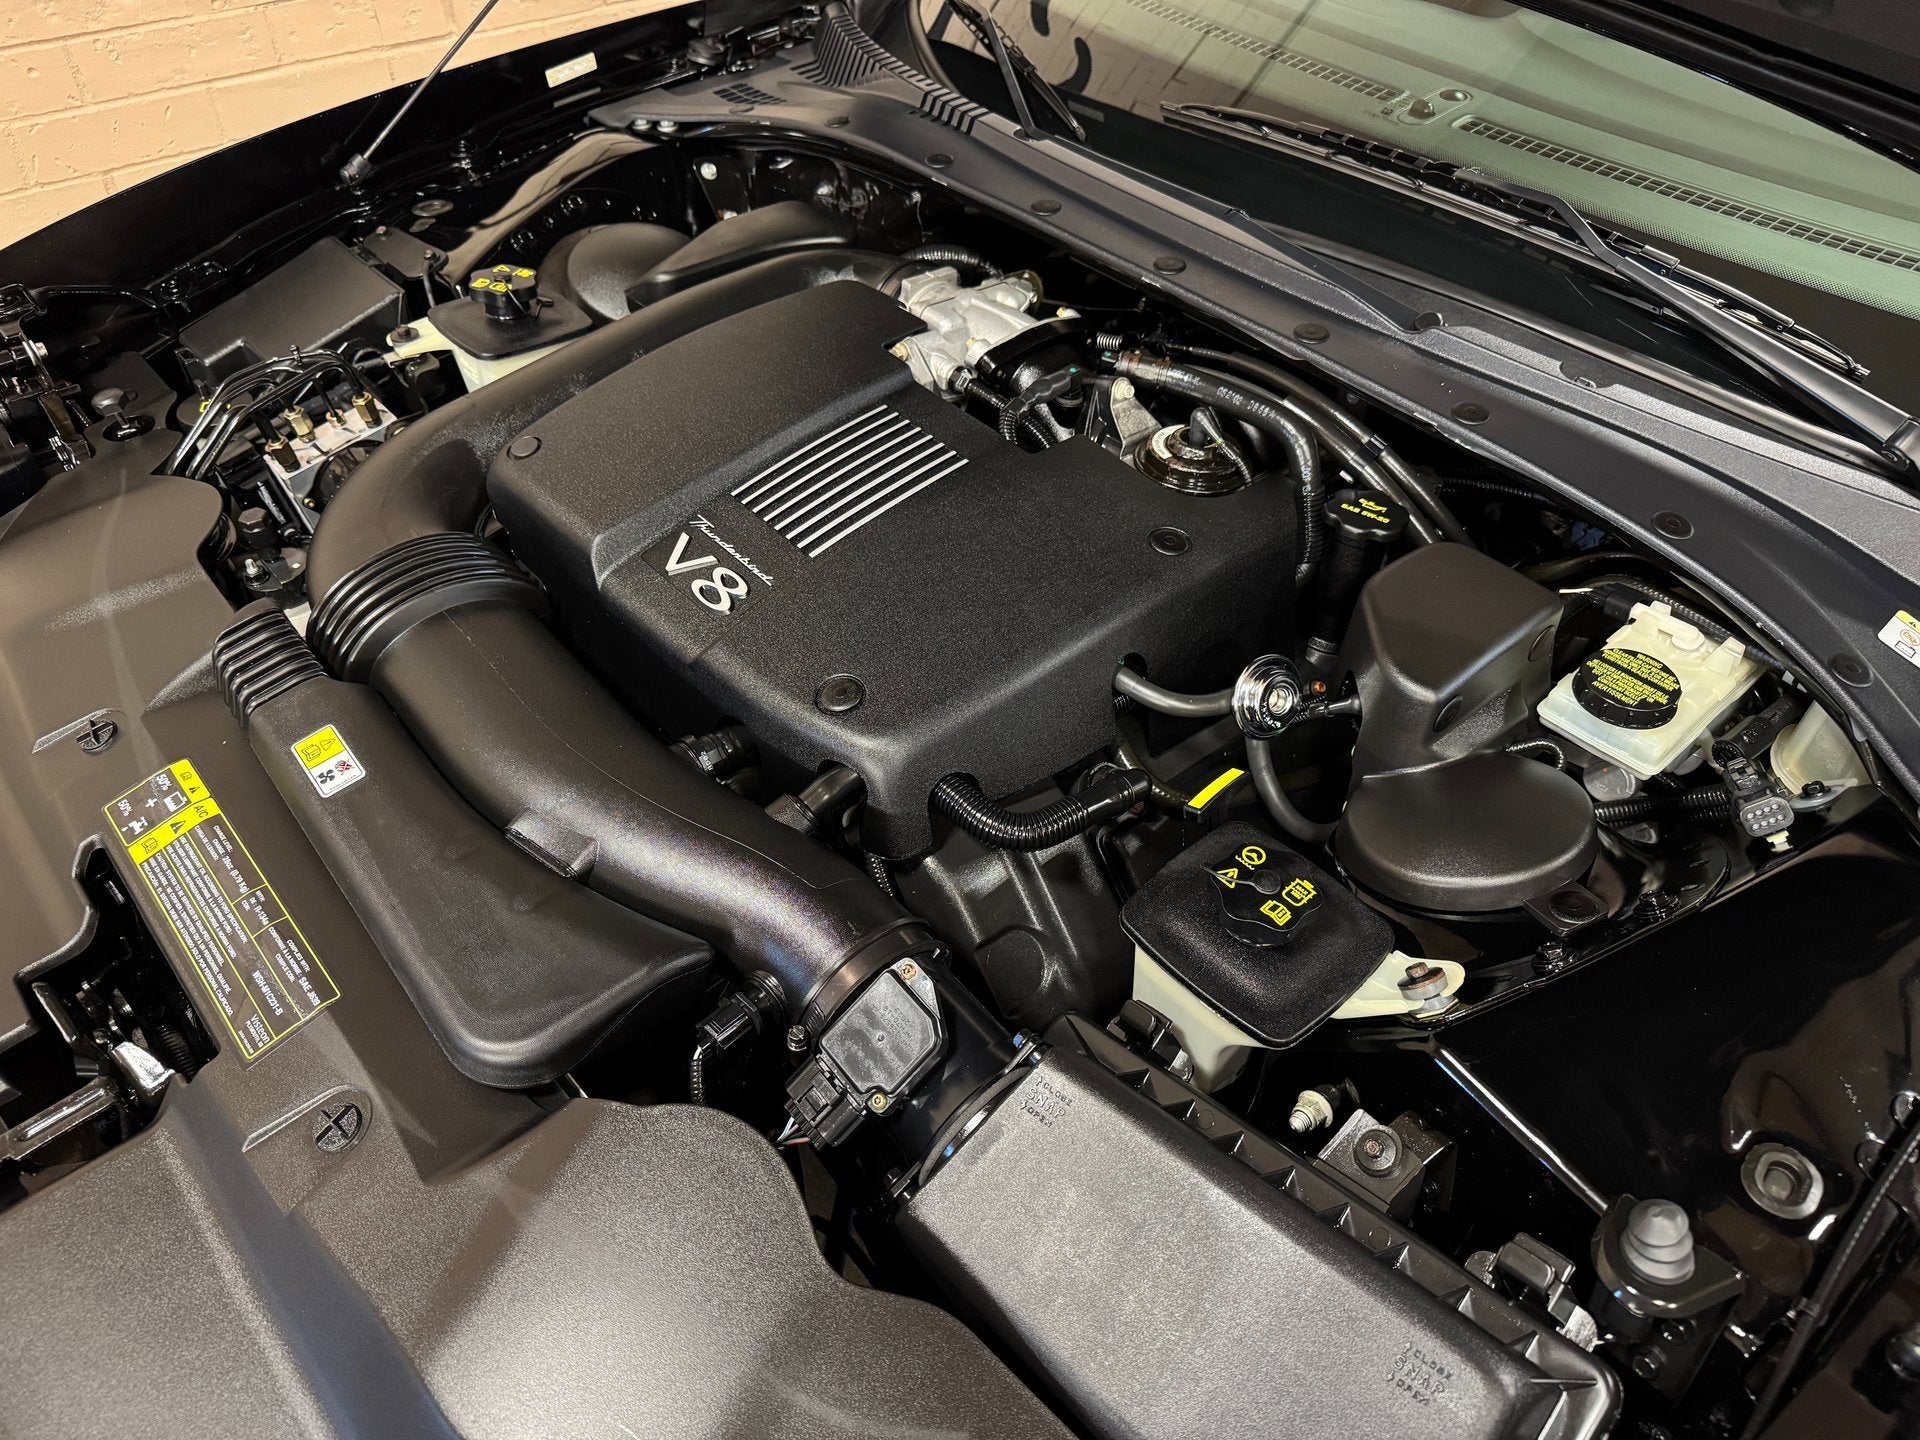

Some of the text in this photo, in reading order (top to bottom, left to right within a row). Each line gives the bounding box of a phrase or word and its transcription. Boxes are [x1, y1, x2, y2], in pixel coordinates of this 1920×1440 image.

[689, 514, 774, 587] Thunderbird
[665, 532, 748, 614] V8
[156, 774, 172, 792] 50%
[117, 799, 134, 817] 50%
[194, 803, 209, 819] A/C
[194, 825, 205, 838] CARGA
[204, 842, 219, 861] LLENADO:
[212, 824, 234, 853] CHARGE LEVEL:
[183, 842, 202, 869] REFRIGERANT
[165, 869, 178, 886] SYSTEM
[198, 867, 207, 876] OIL
[177, 889, 184, 897] BE
[194, 876, 211, 899] CONFORME
[202, 873, 220, 897] ACCORDING
[236, 881, 250, 894] Kg)
[159, 891, 173, 910] SISTEMA
[180, 895, 195, 916] SERVICED
[209, 900, 217, 908] LA
[216, 895, 223, 903] TO
[219, 901, 230, 914] FORD
[168, 908, 179, 920] DEBE
[175, 919, 184, 929] SER
[212, 906, 225, 922] NORME
[253, 904, 270, 925] R-134a
[169, 891, 182, 910] CONFIER
[198, 942, 206, 951] UN
[202, 948, 220, 975] PERSONNEL
[179, 927, 194, 948] ATENDIDO
[194, 919, 211, 942] QUALIFIED
[202, 905, 218, 928] CONFORME
[216, 930, 229, 947] NORMA
[190, 947, 201, 959] SOLO
[197, 958, 206, 969] POR
[206, 940, 225, 967] PERSONNEL.
[286, 938, 311, 973] COMPLIES WITH:
[267, 926, 286, 950] CONFORME
[284, 951, 292, 960] LA
[298, 976, 311, 992] SAE
[306, 989, 320, 1006] J639
[274, 953, 296, 983] CUMPLE CON:
[202, 967, 219, 991] PERSONAL
[214, 988, 233, 1017] CALIFICADO.
[251, 970, 283, 1016] WSH-M1C231-B
[249, 1013, 271, 1043] Visteon
[1027, 1088, 1065, 1119] SNAP
[1393, 1354, 1445, 1395] SNAP
